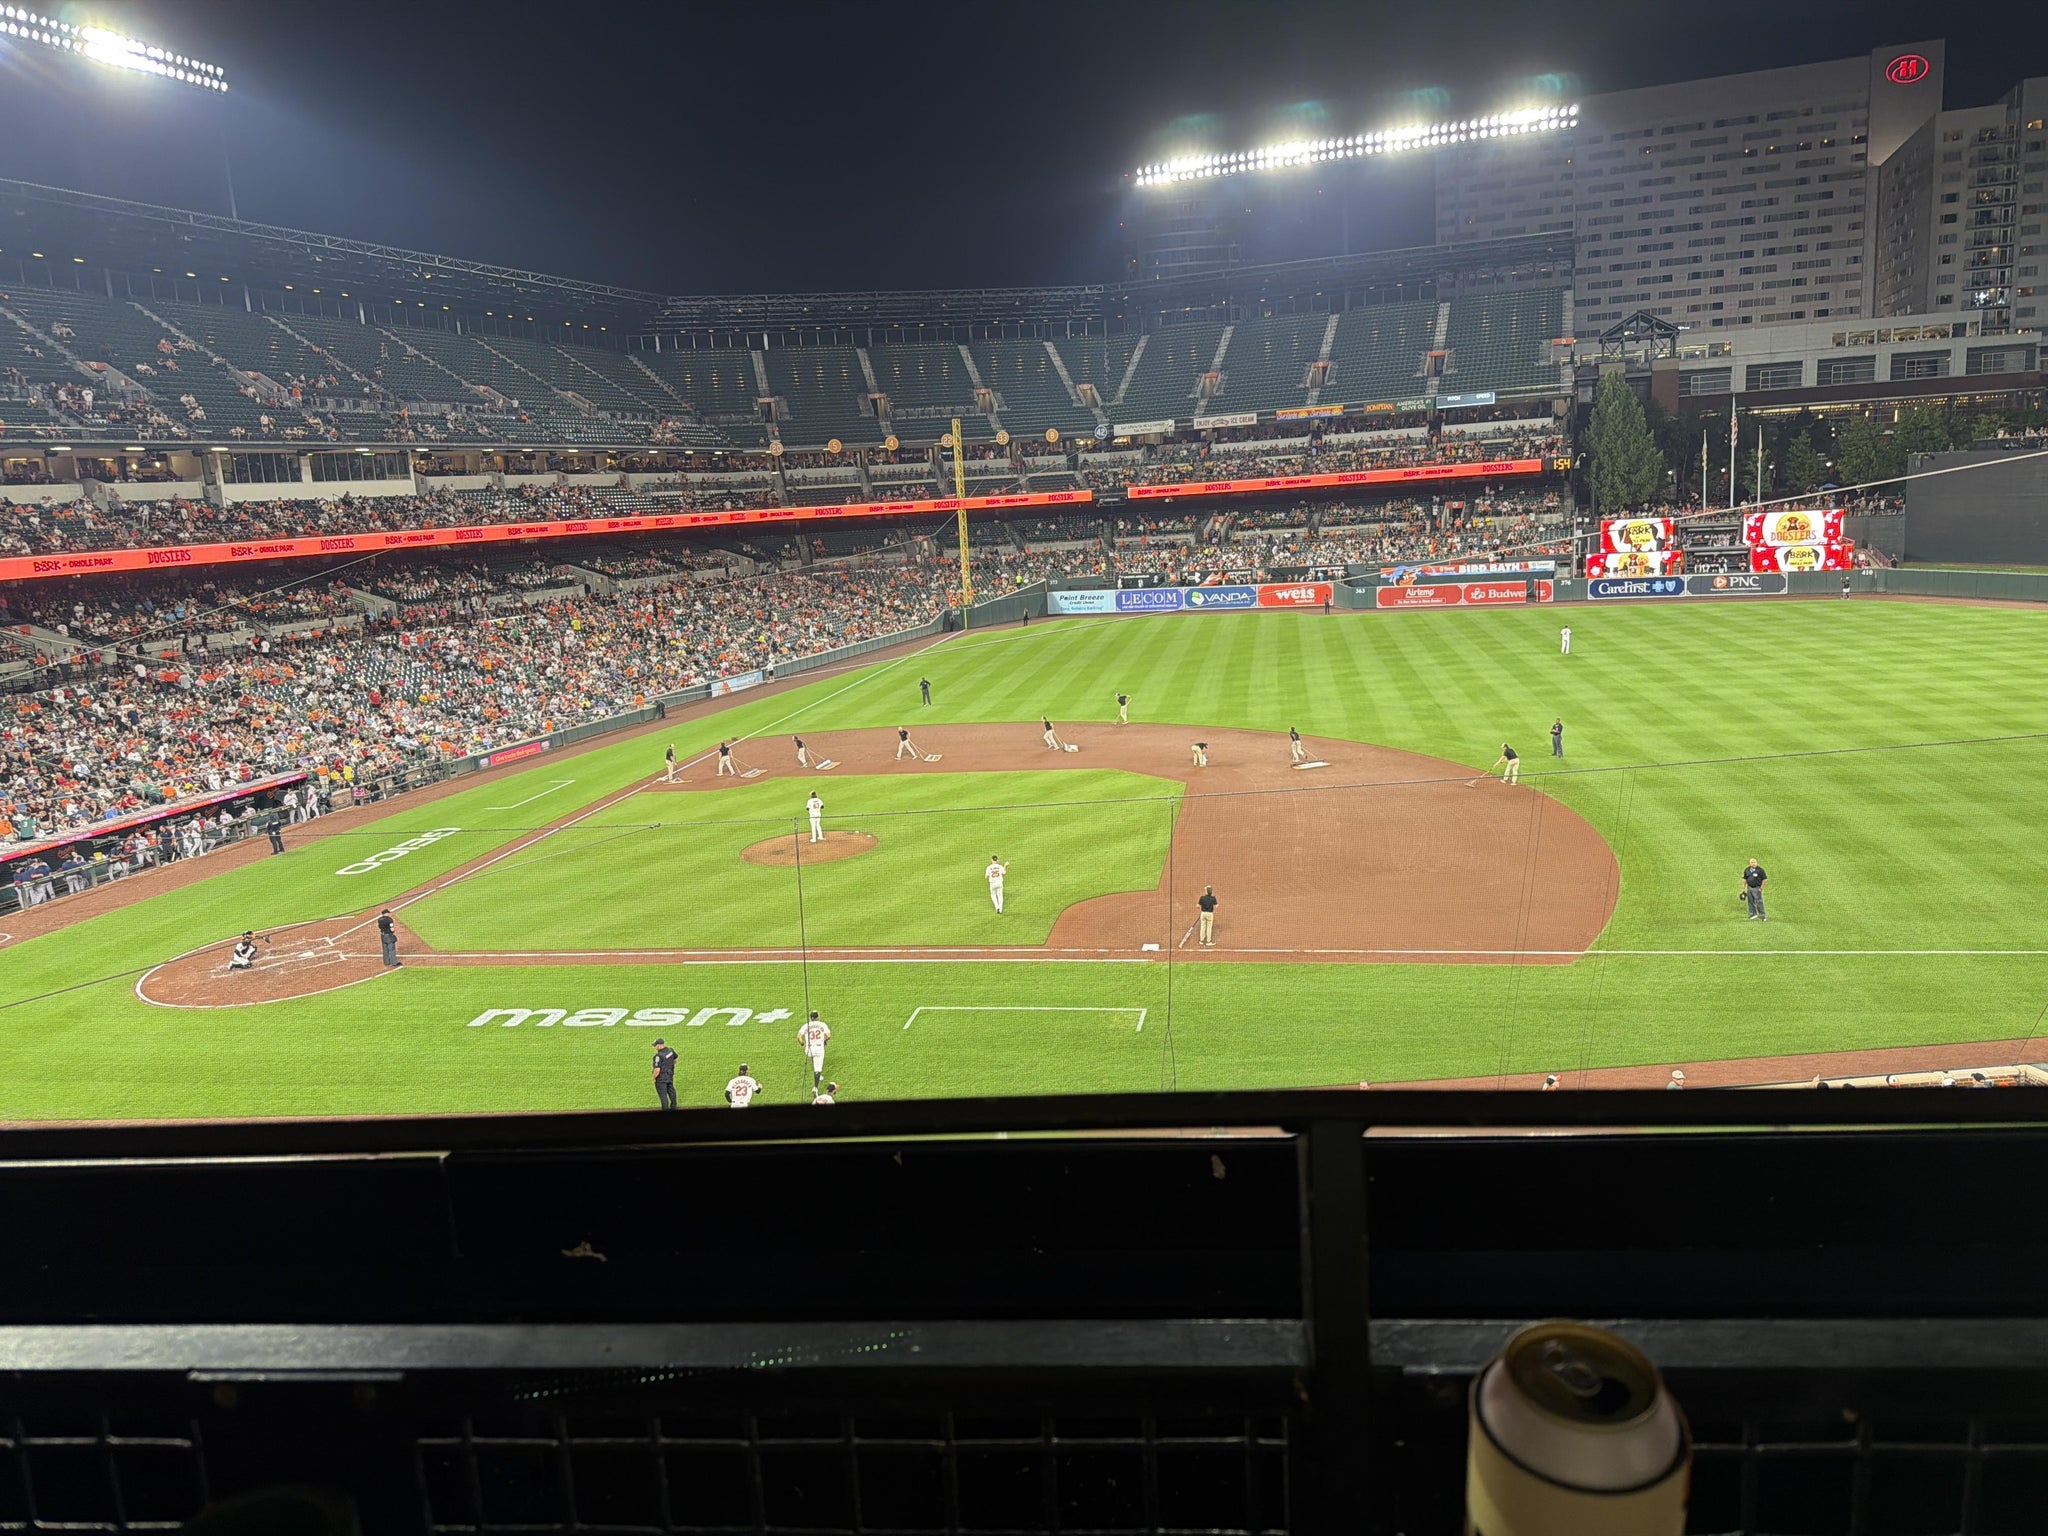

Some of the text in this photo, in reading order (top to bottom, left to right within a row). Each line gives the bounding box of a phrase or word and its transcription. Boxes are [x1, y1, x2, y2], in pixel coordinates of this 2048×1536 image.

[1482, 463, 1513, 472] DOGSTERS
[1553, 458, 1571, 470] 1:54
[1770, 530, 1816, 542] DOGSTERS
[320, 538, 354, 551] DOGSTERS
[148, 549, 192, 564] DOGSTERS
[69, 559, 93, 568] ORIOLE
[94, 558, 113, 566] PARK
[1459, 564, 1487, 573] BIRD
[1490, 563, 1520, 572] BATH
[1729, 576, 1759, 587] PNC
[1406, 588, 1435, 596] Airtemp
[1598, 581, 1650, 594] CareFirst
[1122, 593, 1178, 605] LECOM
[1204, 592, 1250, 602] VANDA
[1276, 588, 1315, 600] weis
[991, 870, 1000, 878] 25
[810, 1030, 821, 1040] 32
[736, 1086, 747, 1096] 23
